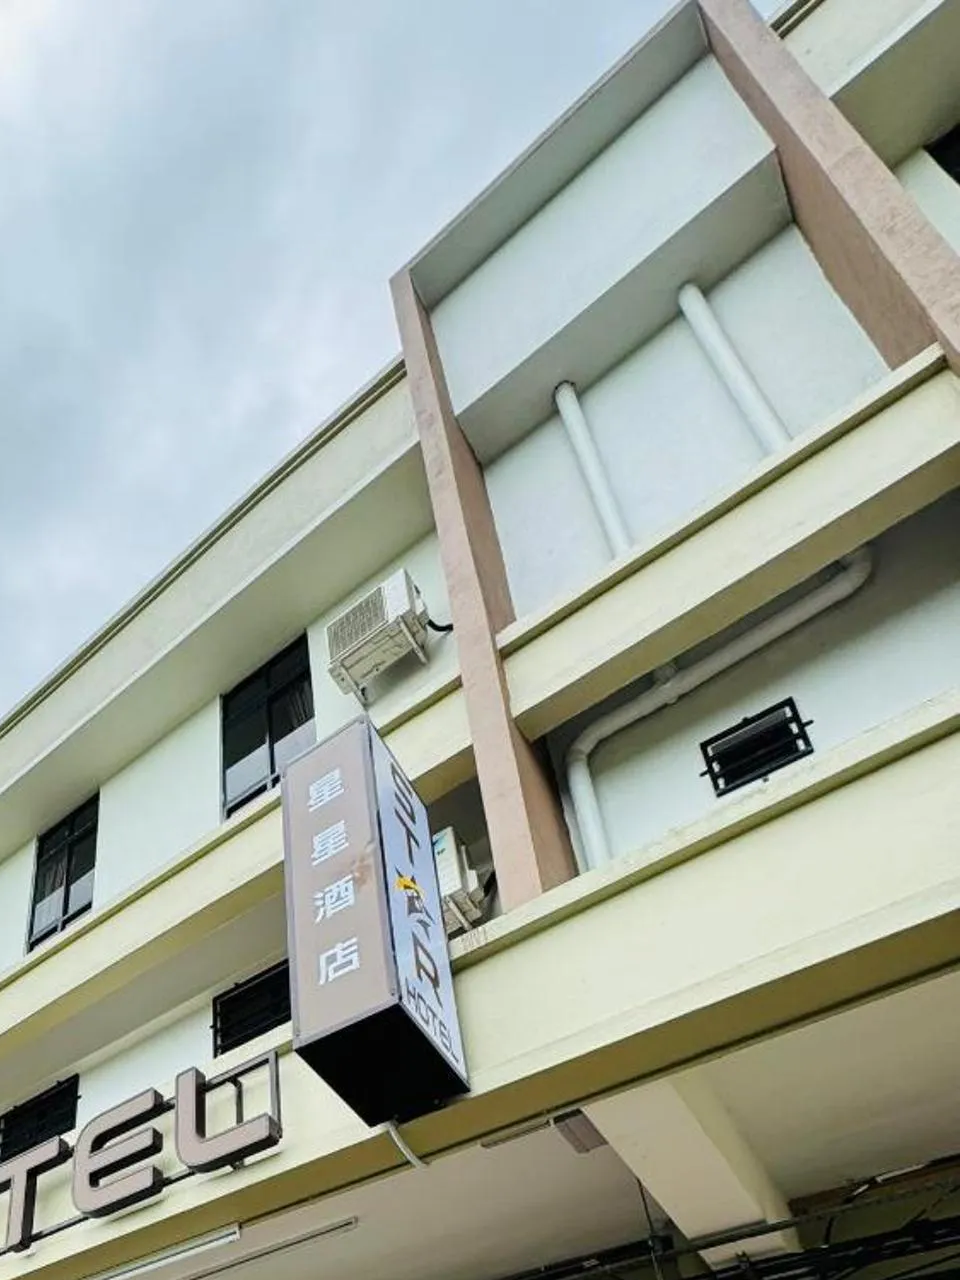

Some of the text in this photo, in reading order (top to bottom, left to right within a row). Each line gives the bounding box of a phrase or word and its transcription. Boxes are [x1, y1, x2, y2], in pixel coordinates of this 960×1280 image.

[308, 767, 361, 986] 星星酒店
[405, 976, 460, 1063] HOTEL
